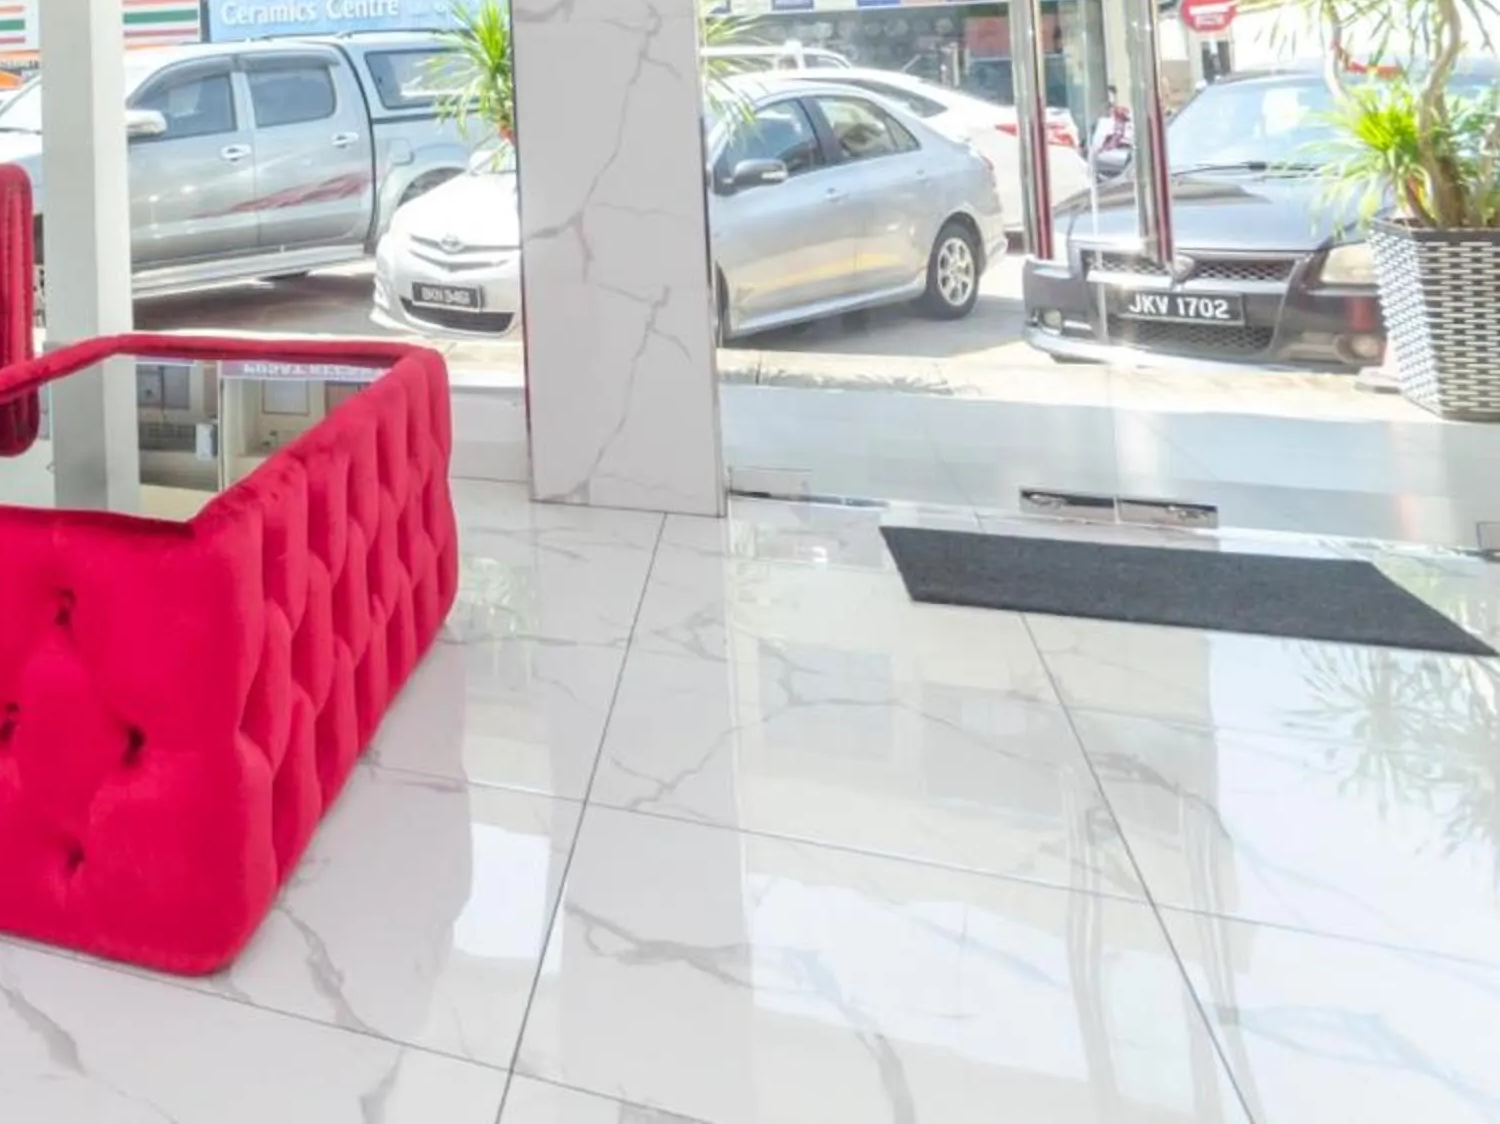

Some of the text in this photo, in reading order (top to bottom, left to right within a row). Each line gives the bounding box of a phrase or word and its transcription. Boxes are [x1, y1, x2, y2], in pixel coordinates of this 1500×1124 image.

[220, 0, 318, 25] Ceramics
[1128, 293, 1230, 319] JKV 1702
